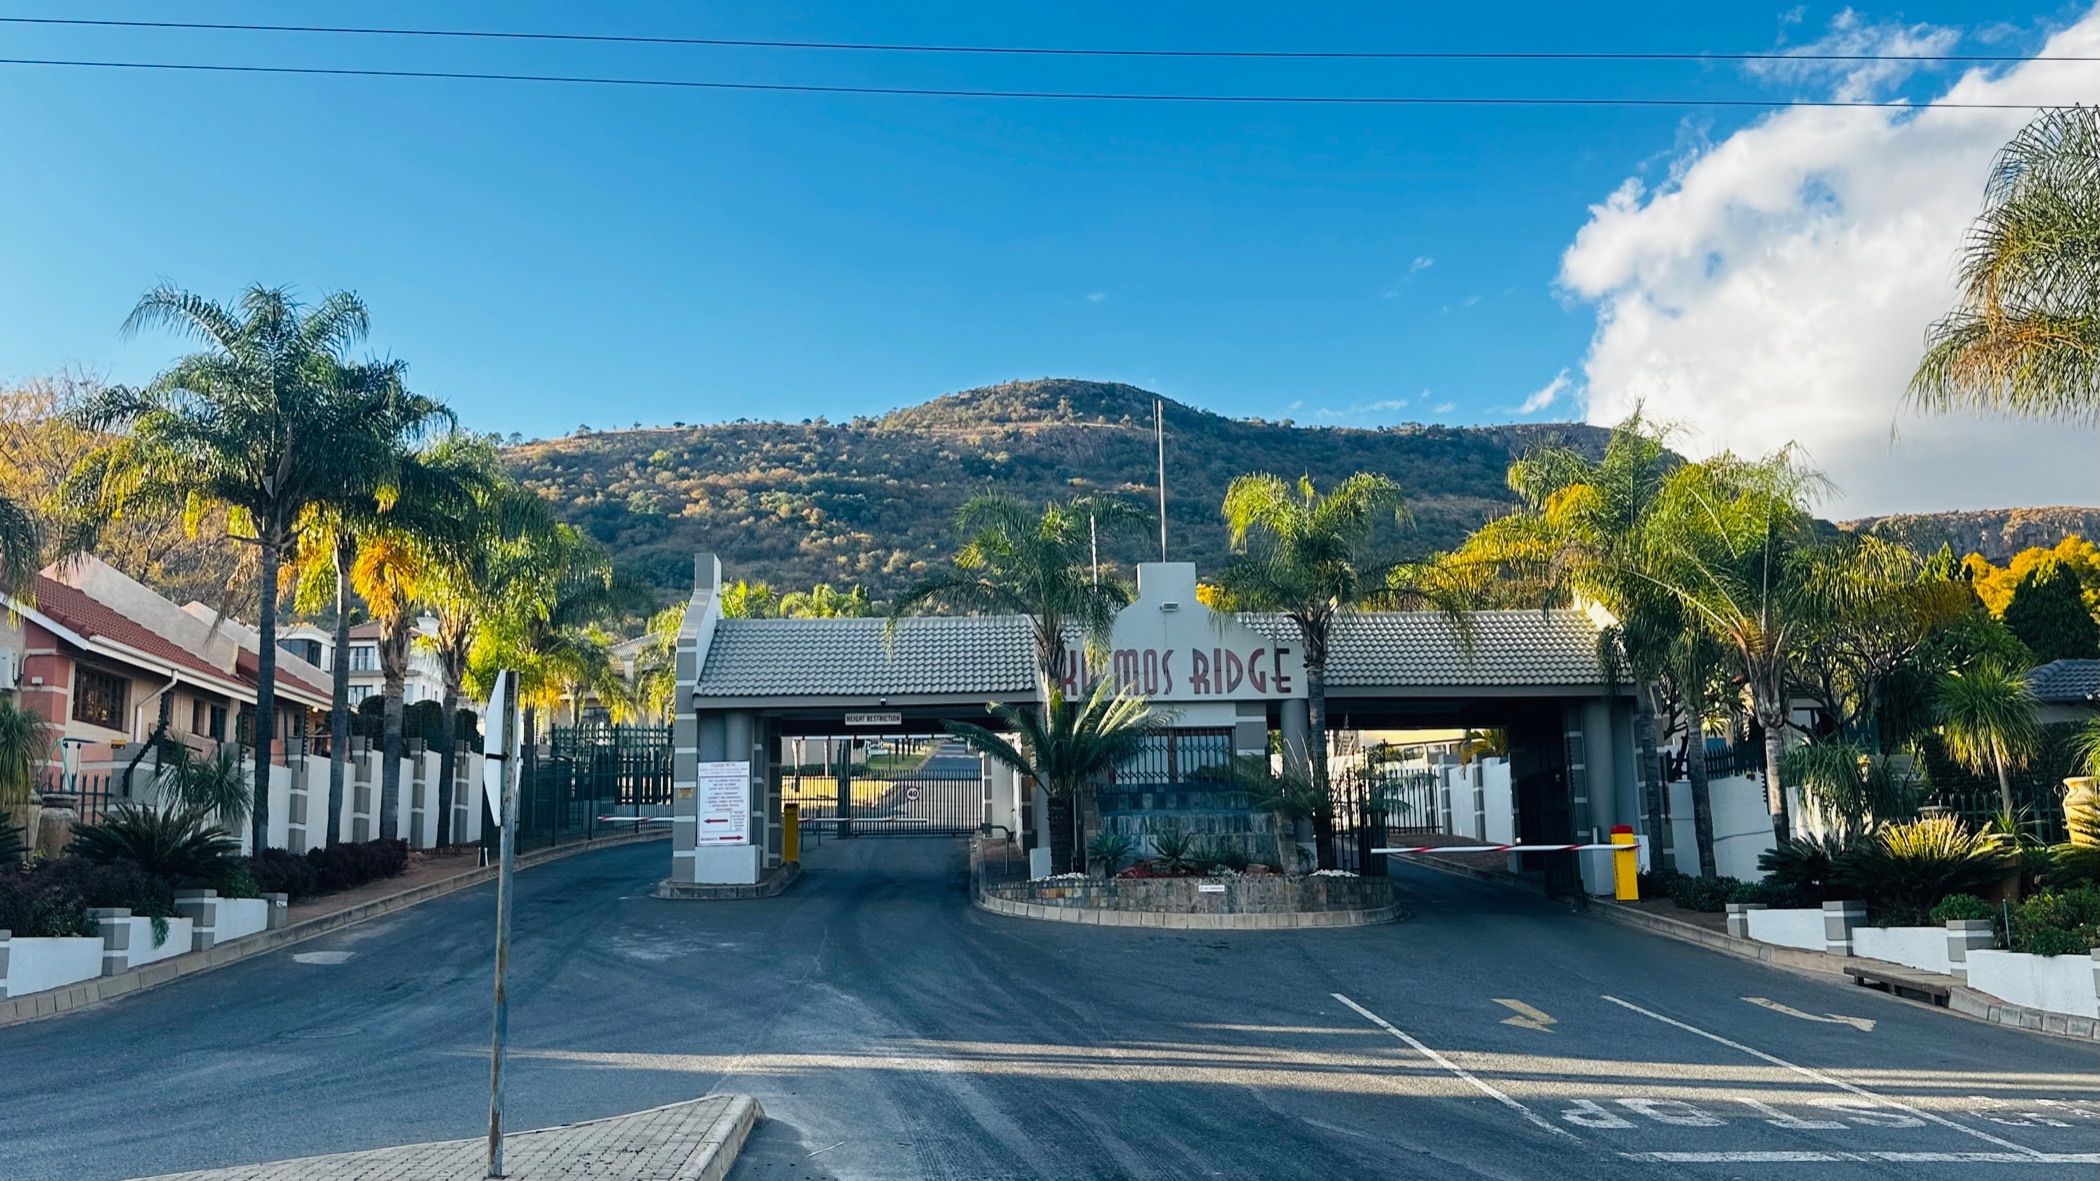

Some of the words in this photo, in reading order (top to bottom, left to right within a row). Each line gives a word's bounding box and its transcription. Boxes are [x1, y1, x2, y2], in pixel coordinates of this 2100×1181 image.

[1060, 649, 1174, 695] KMOS
[1189, 648, 1291, 694] RIDGE
[867, 714, 900, 722] RESTRICTION
